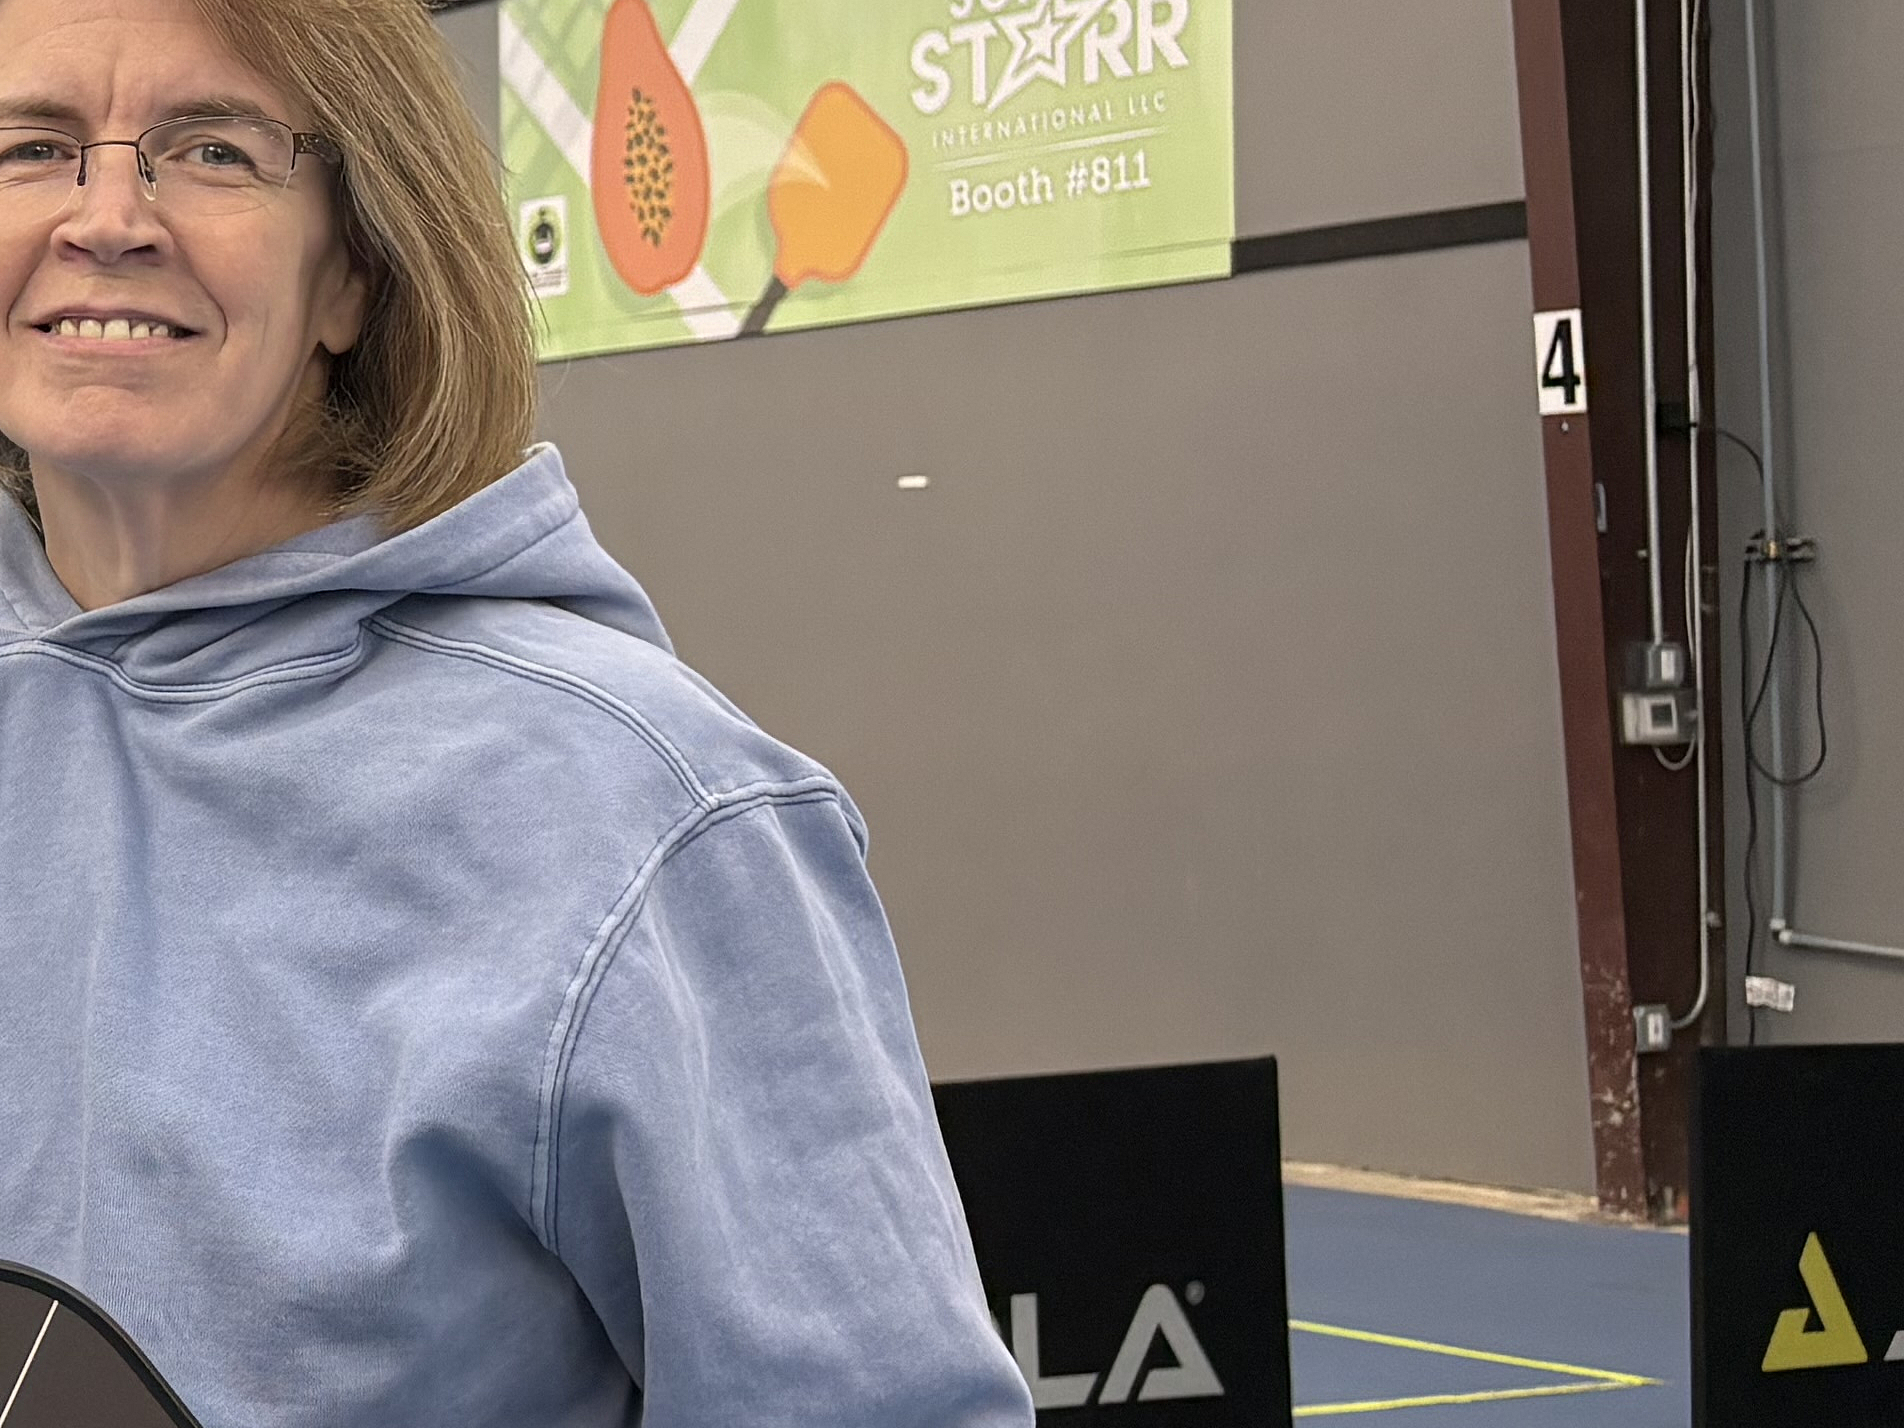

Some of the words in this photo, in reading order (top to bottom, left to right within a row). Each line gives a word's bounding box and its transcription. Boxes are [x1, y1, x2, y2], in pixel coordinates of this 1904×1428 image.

[932, 99, 1113, 149] INTERNATIONAL
[1128, 89, 1169, 119] LLC
[949, 164, 1056, 218] Booth
[1066, 147, 1153, 200] #811
[1542, 317, 1581, 406] 4
